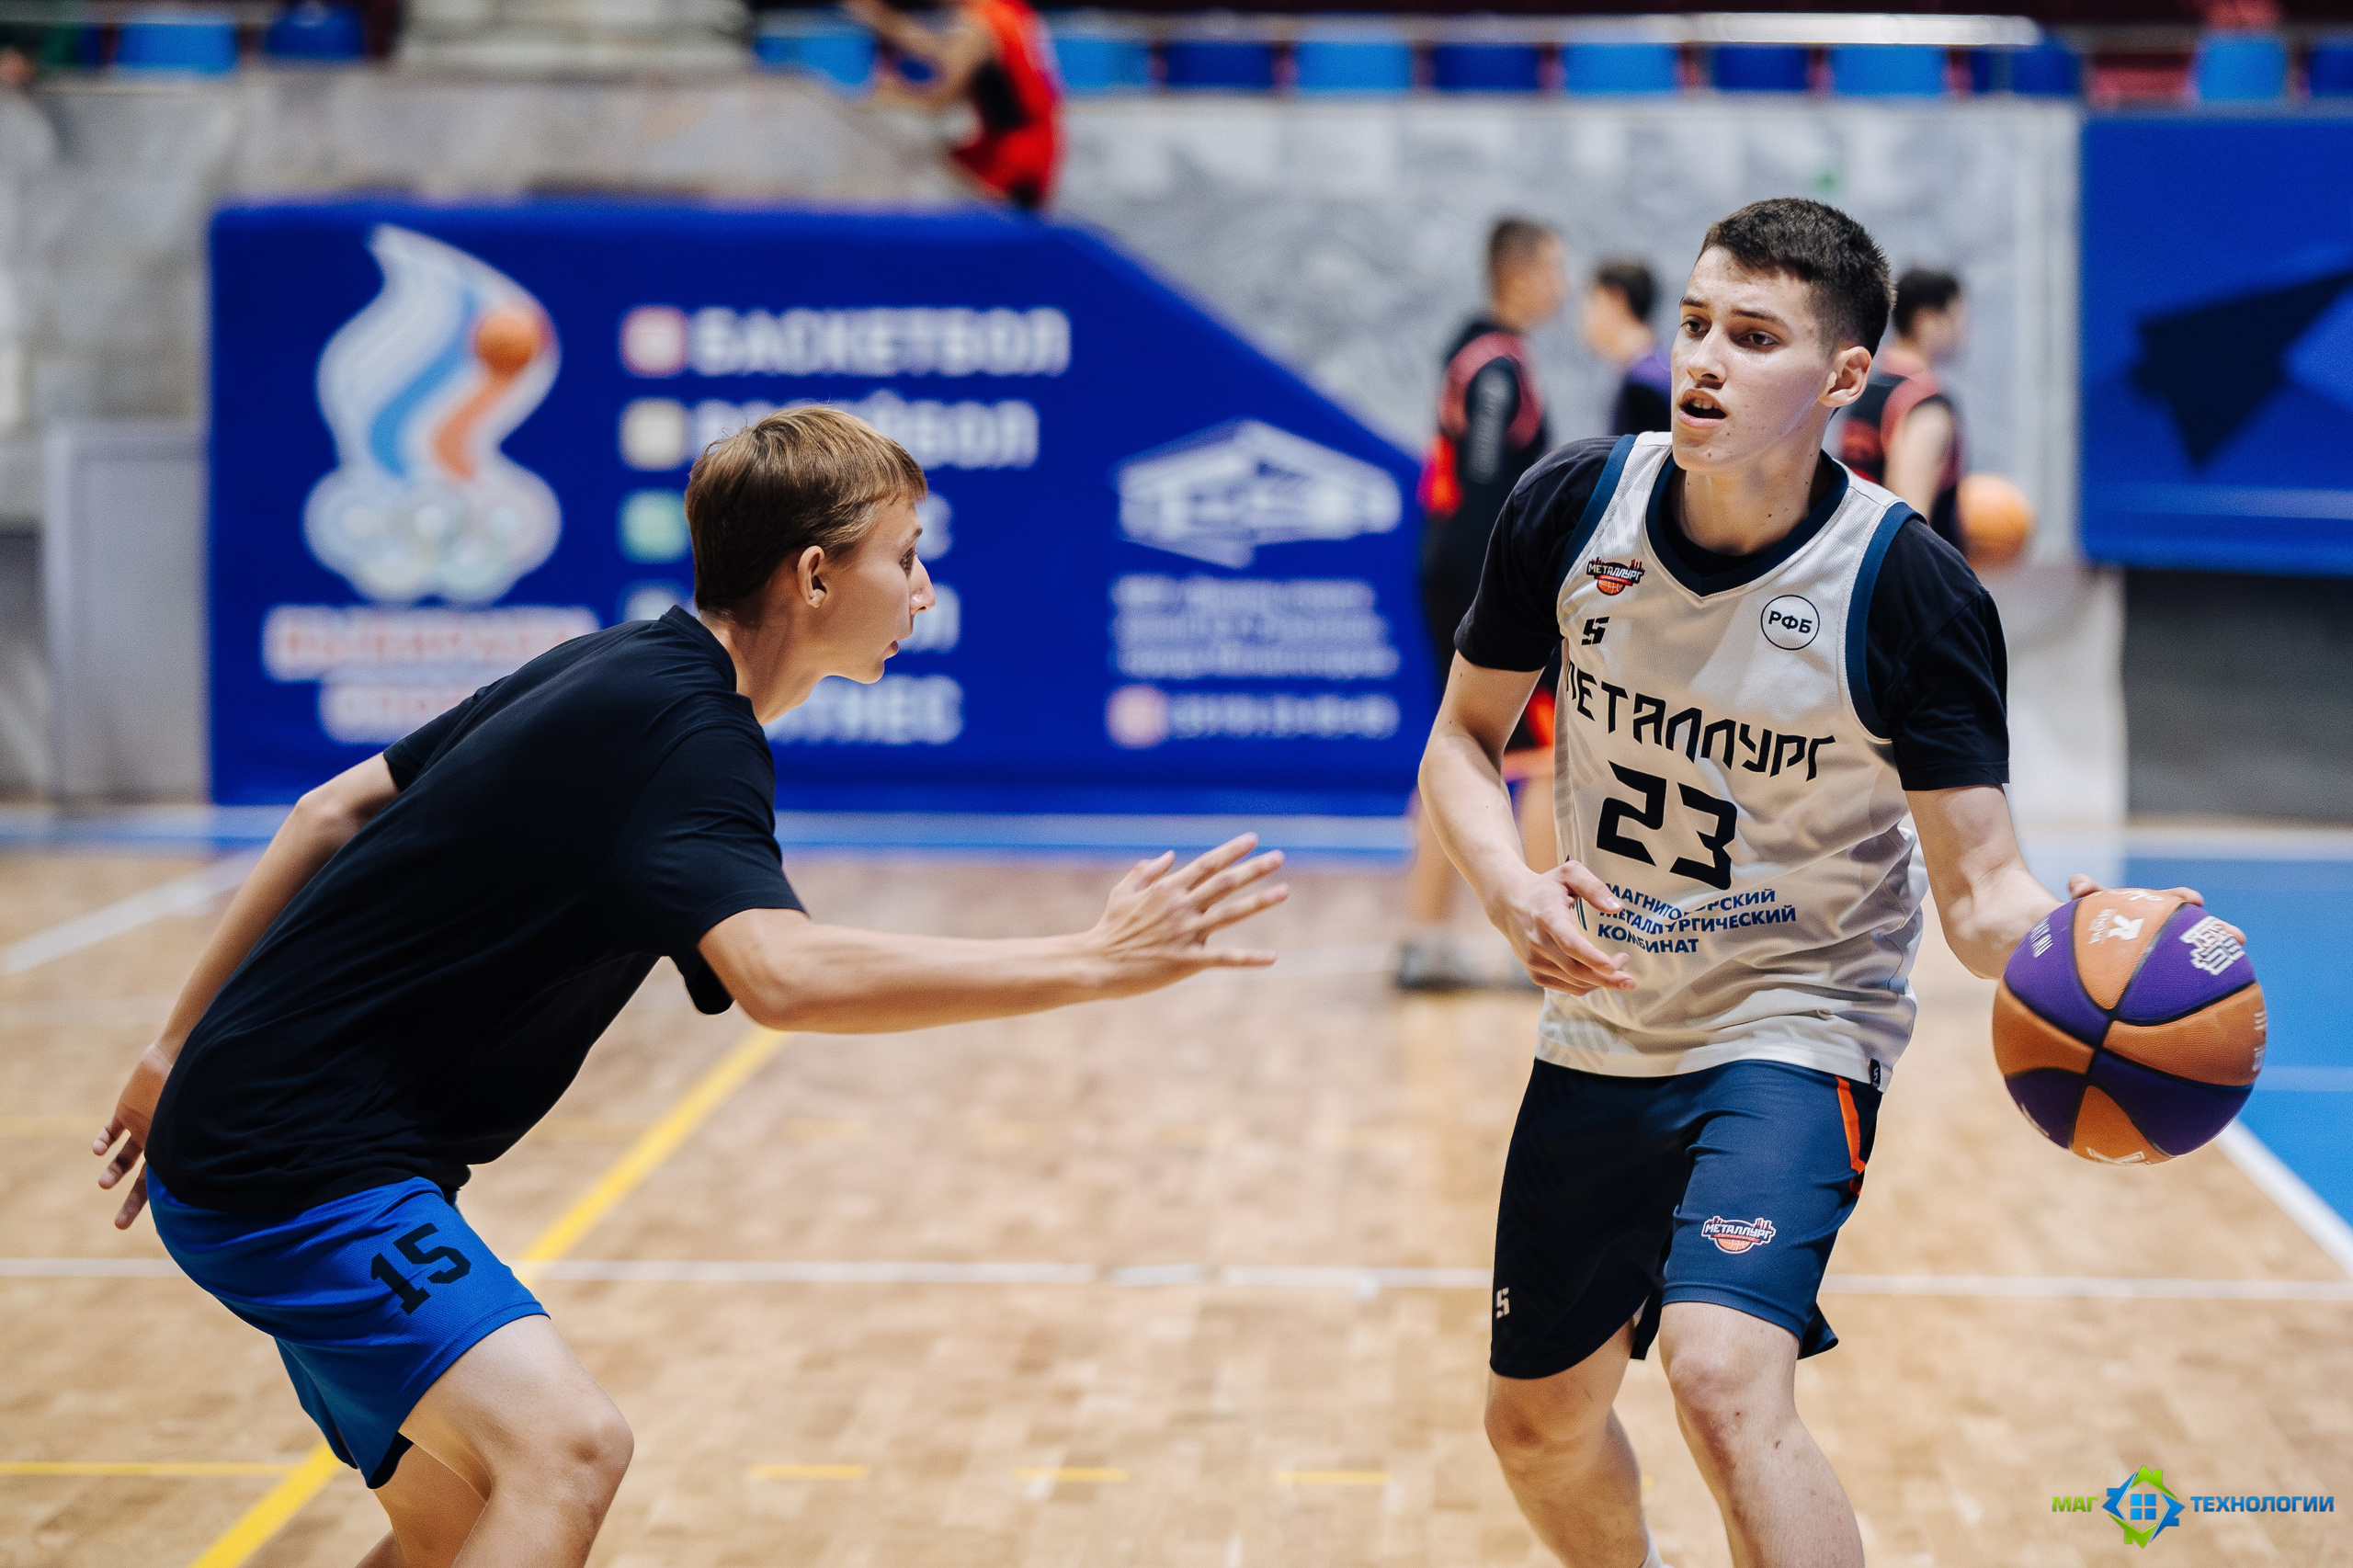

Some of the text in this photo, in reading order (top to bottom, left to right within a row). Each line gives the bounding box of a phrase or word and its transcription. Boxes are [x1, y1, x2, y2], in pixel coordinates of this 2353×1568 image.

[691, 309, 1071, 376] БАСКЕТБОЛ
[1587, 562, 1643, 581] МЕТАЛЛУРГ
[1768, 610, 1813, 634] РФБ
[1597, 760, 1737, 891] 23
[1606, 882, 1776, 920] МАГНИТОРСКИЙ
[1599, 904, 1797, 935] ЕТАЛЛУРГИЧЕСКИЙ
[1597, 924, 1699, 954] КОМБИНАТ
[1704, 1223, 1773, 1239] МЕТАЛЛУРГ
[370, 1221, 472, 1315] 15
